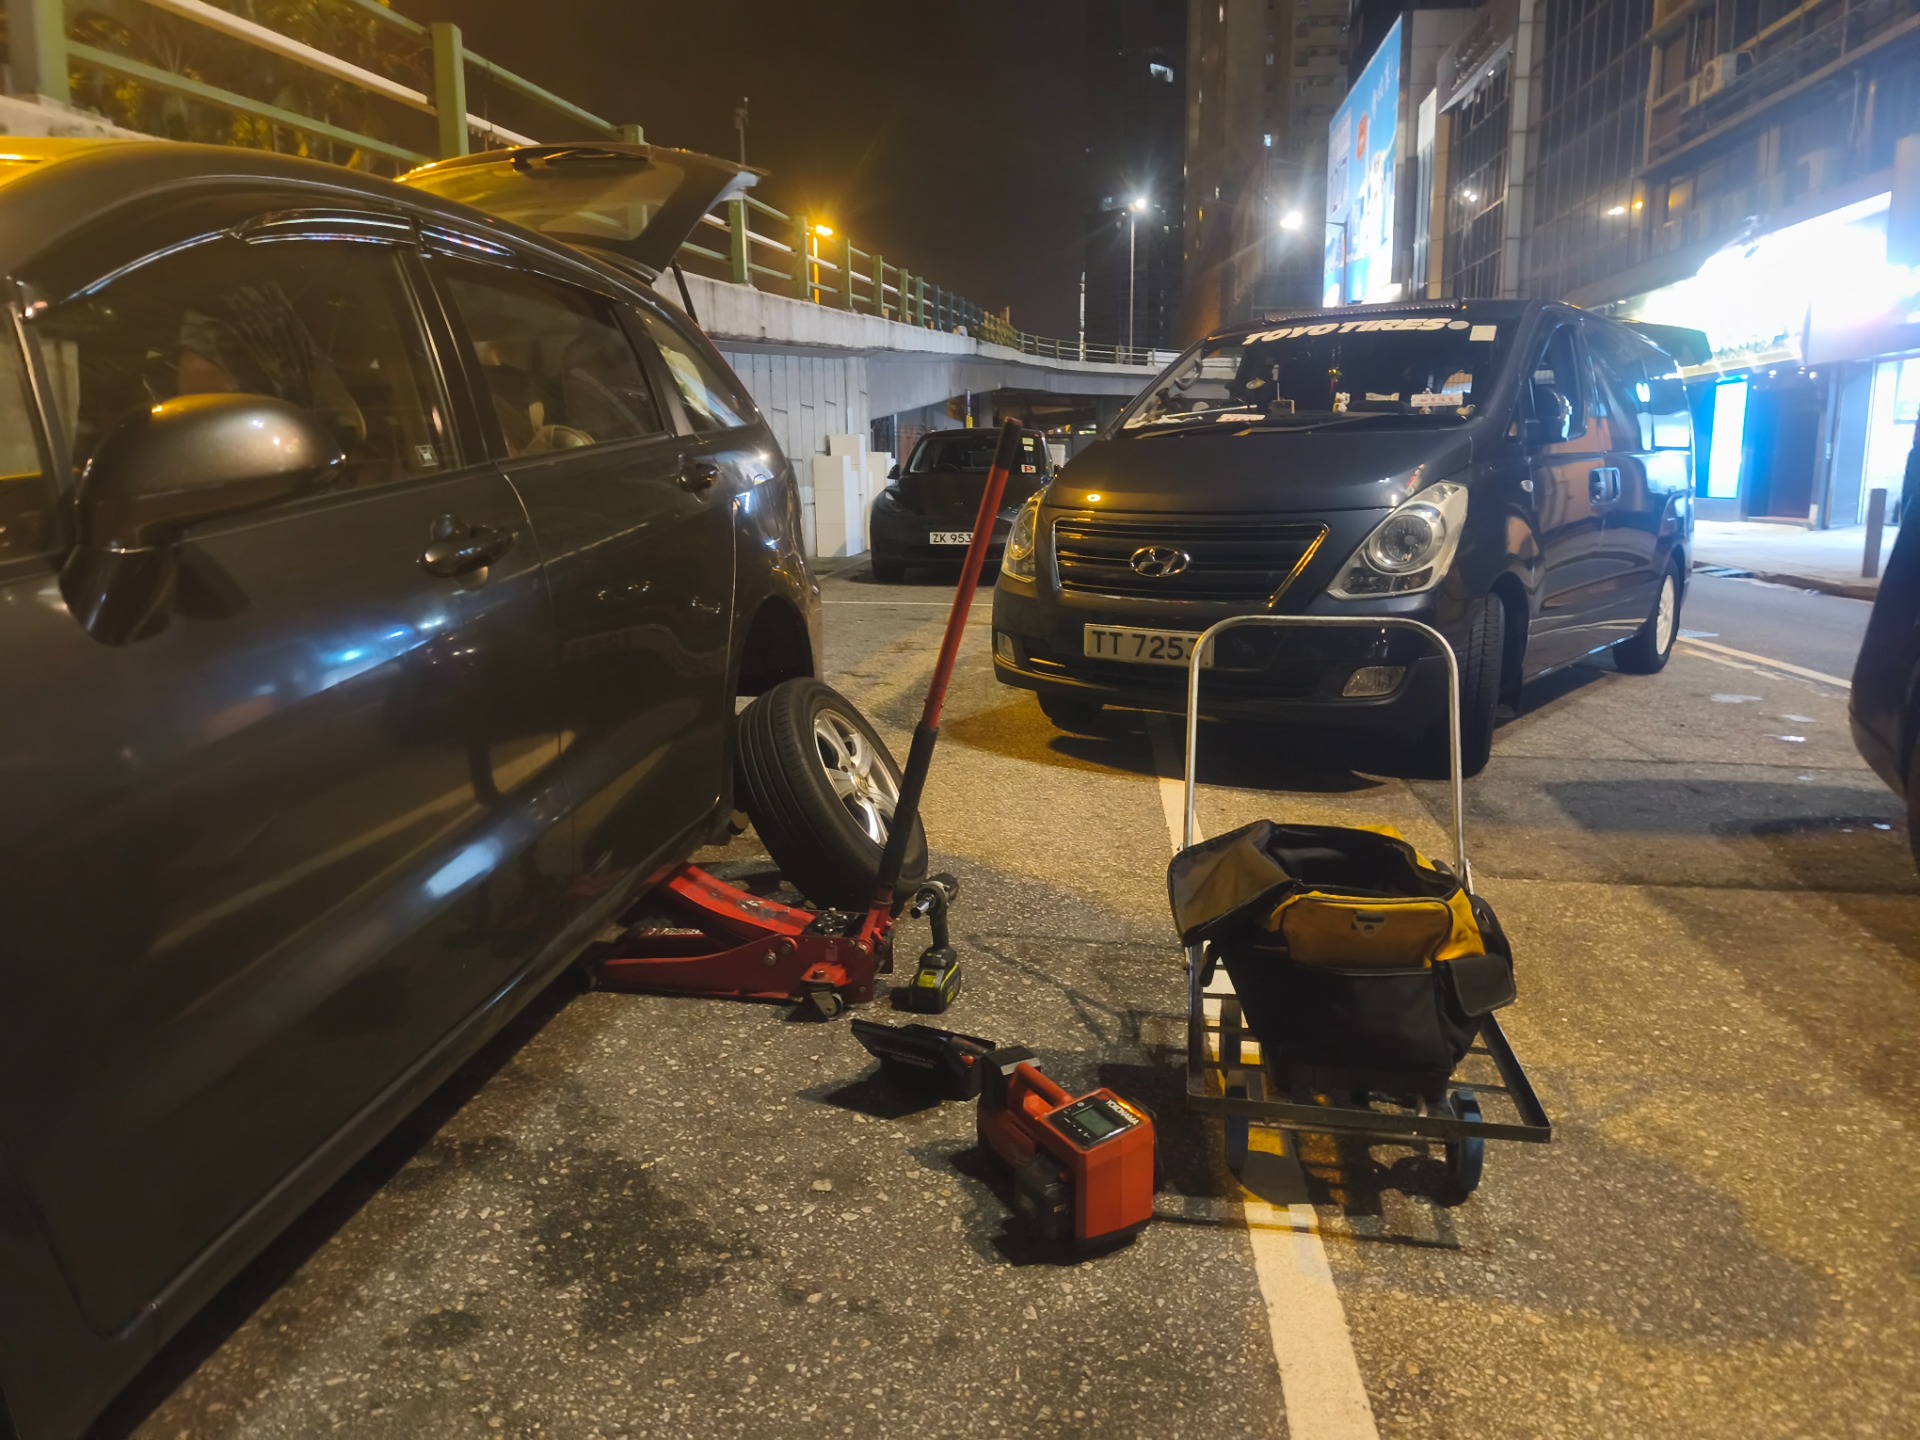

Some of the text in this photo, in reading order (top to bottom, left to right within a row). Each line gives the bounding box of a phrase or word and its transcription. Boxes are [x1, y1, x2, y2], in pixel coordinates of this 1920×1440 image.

[1242, 318, 1452, 345] TOYO TIRES
[932, 533, 946, 543] ZK
[1092, 630, 1123, 655] TT
